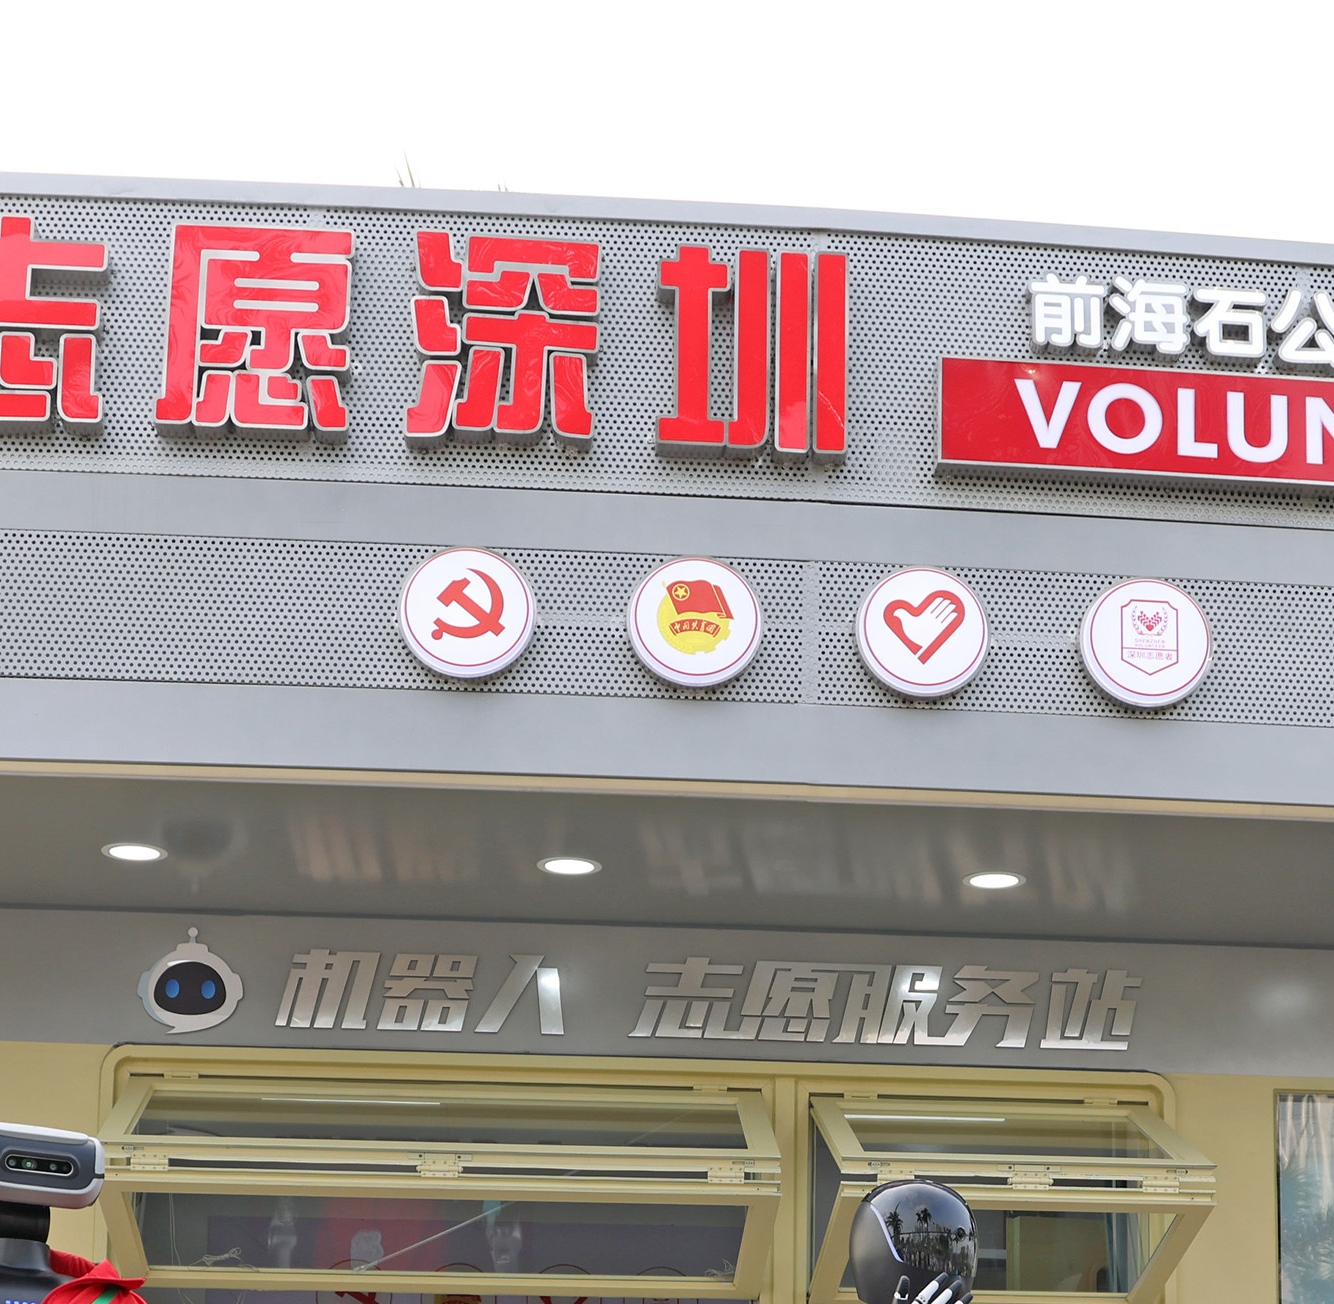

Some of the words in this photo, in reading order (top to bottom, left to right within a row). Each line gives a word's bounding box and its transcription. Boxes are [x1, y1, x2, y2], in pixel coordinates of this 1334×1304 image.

[273, 947, 564, 1037] 机器人
[627, 956, 1142, 1051] 志愿服务站
